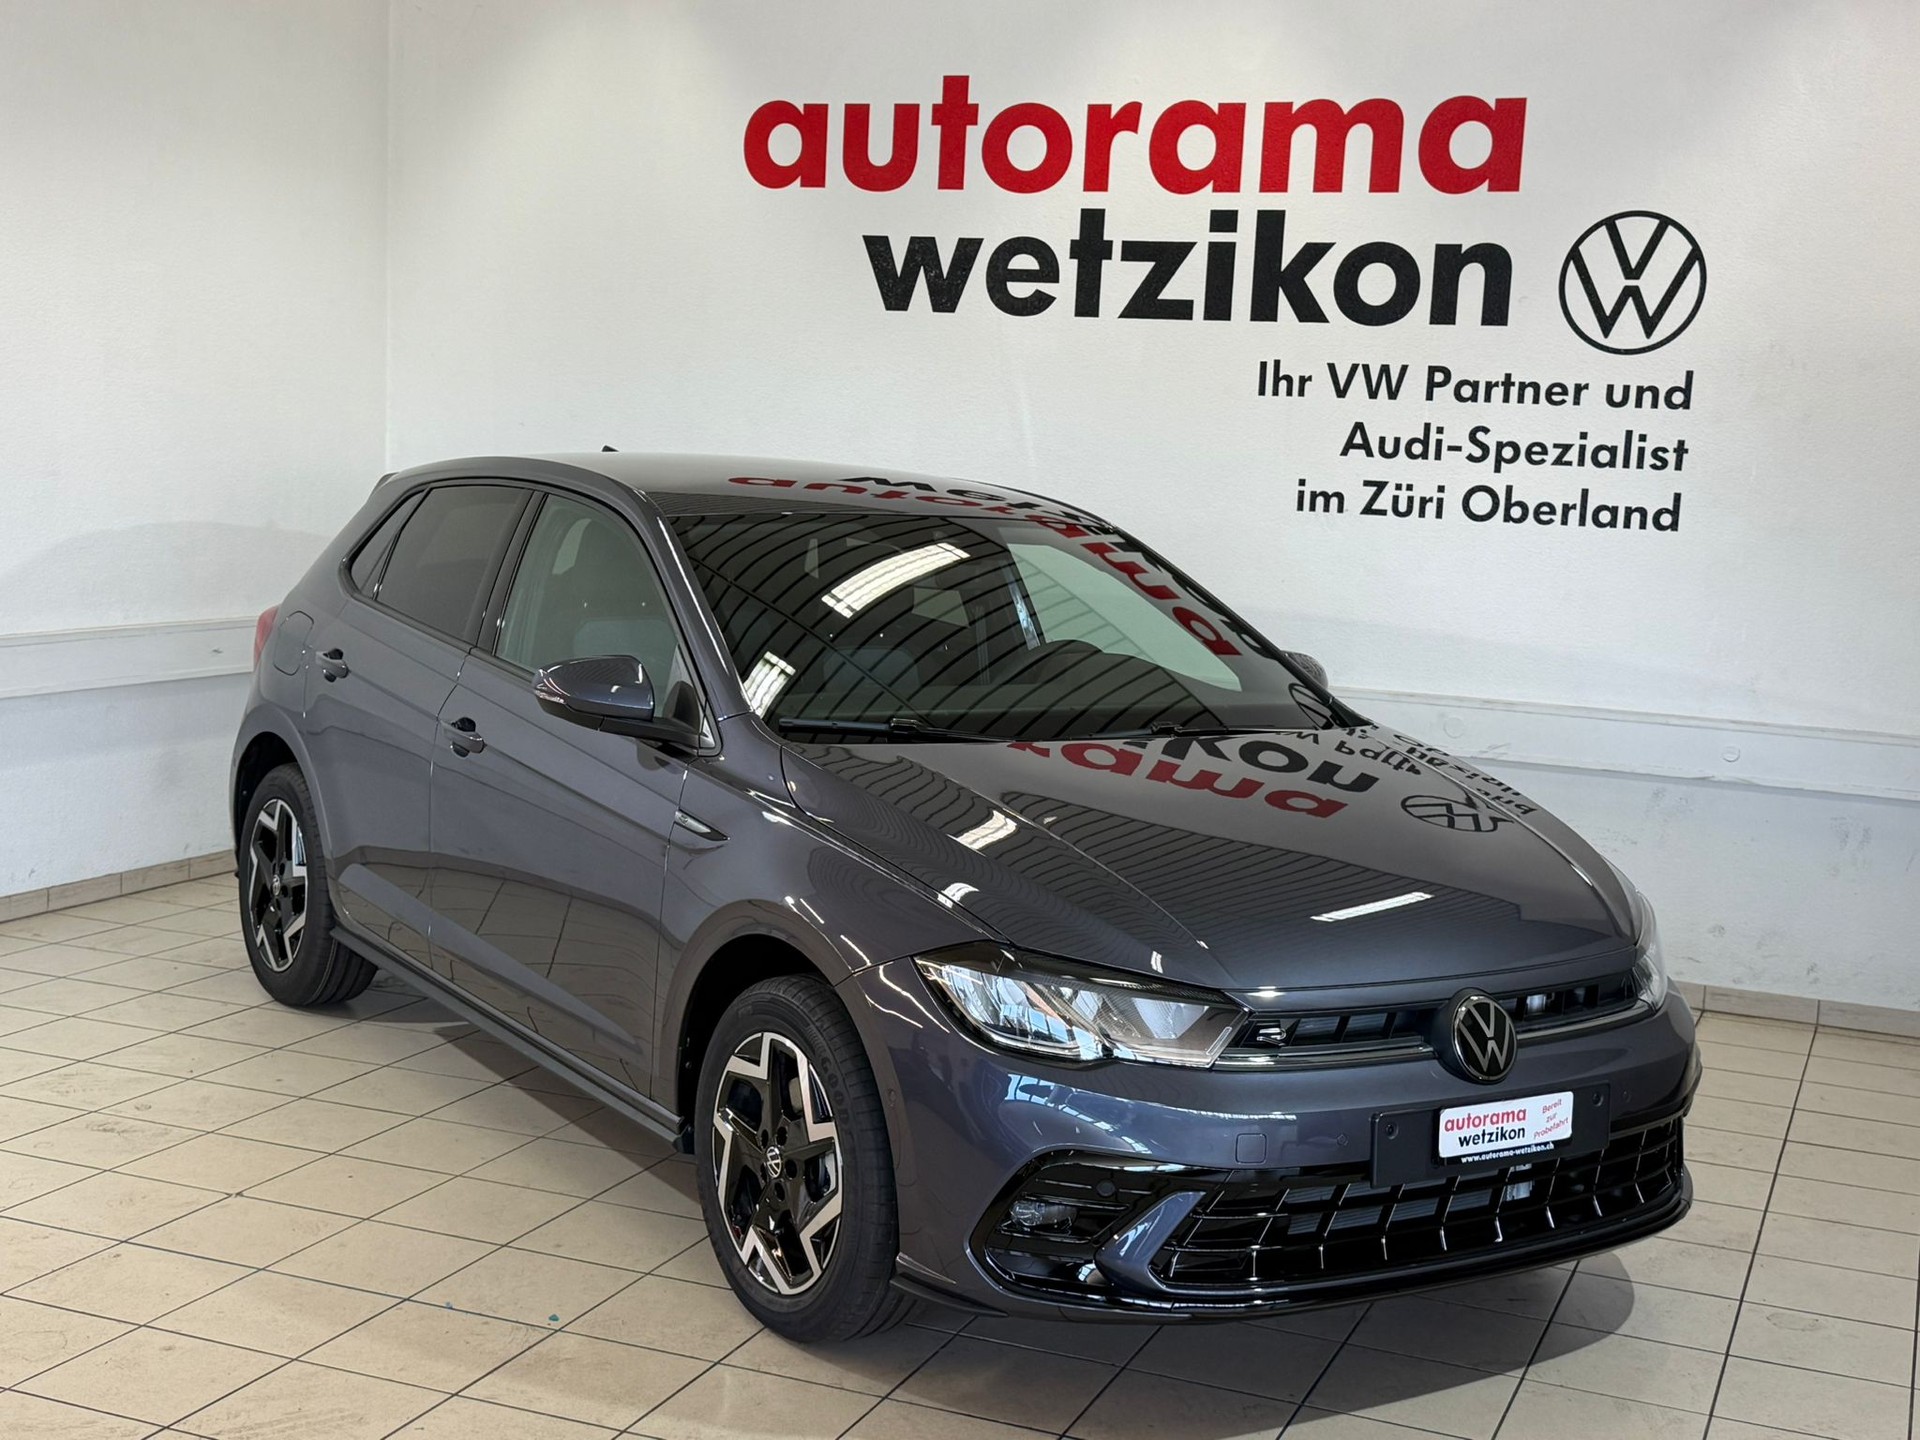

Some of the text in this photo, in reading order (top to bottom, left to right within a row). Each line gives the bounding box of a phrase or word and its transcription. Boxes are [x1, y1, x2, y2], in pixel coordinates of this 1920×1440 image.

[744, 75, 1528, 195] autorama
[862, 208, 1513, 327] wetzikon
[1258, 359, 1694, 410] Ihr VW Partner und
[1339, 421, 1689, 474] Audi-Spezialist
[1296, 478, 1682, 532] im Züri Oberland
[1541, 1099, 1562, 1114] Bereit
[1545, 1112, 1558, 1123] zur
[1444, 1108, 1527, 1132] autorama
[1533, 1117, 1569, 1140] Probefahrt
[1458, 1127, 1525, 1147] wetzikon
[1460, 1142, 1555, 1163] www.autorama-wetzikon.ch
